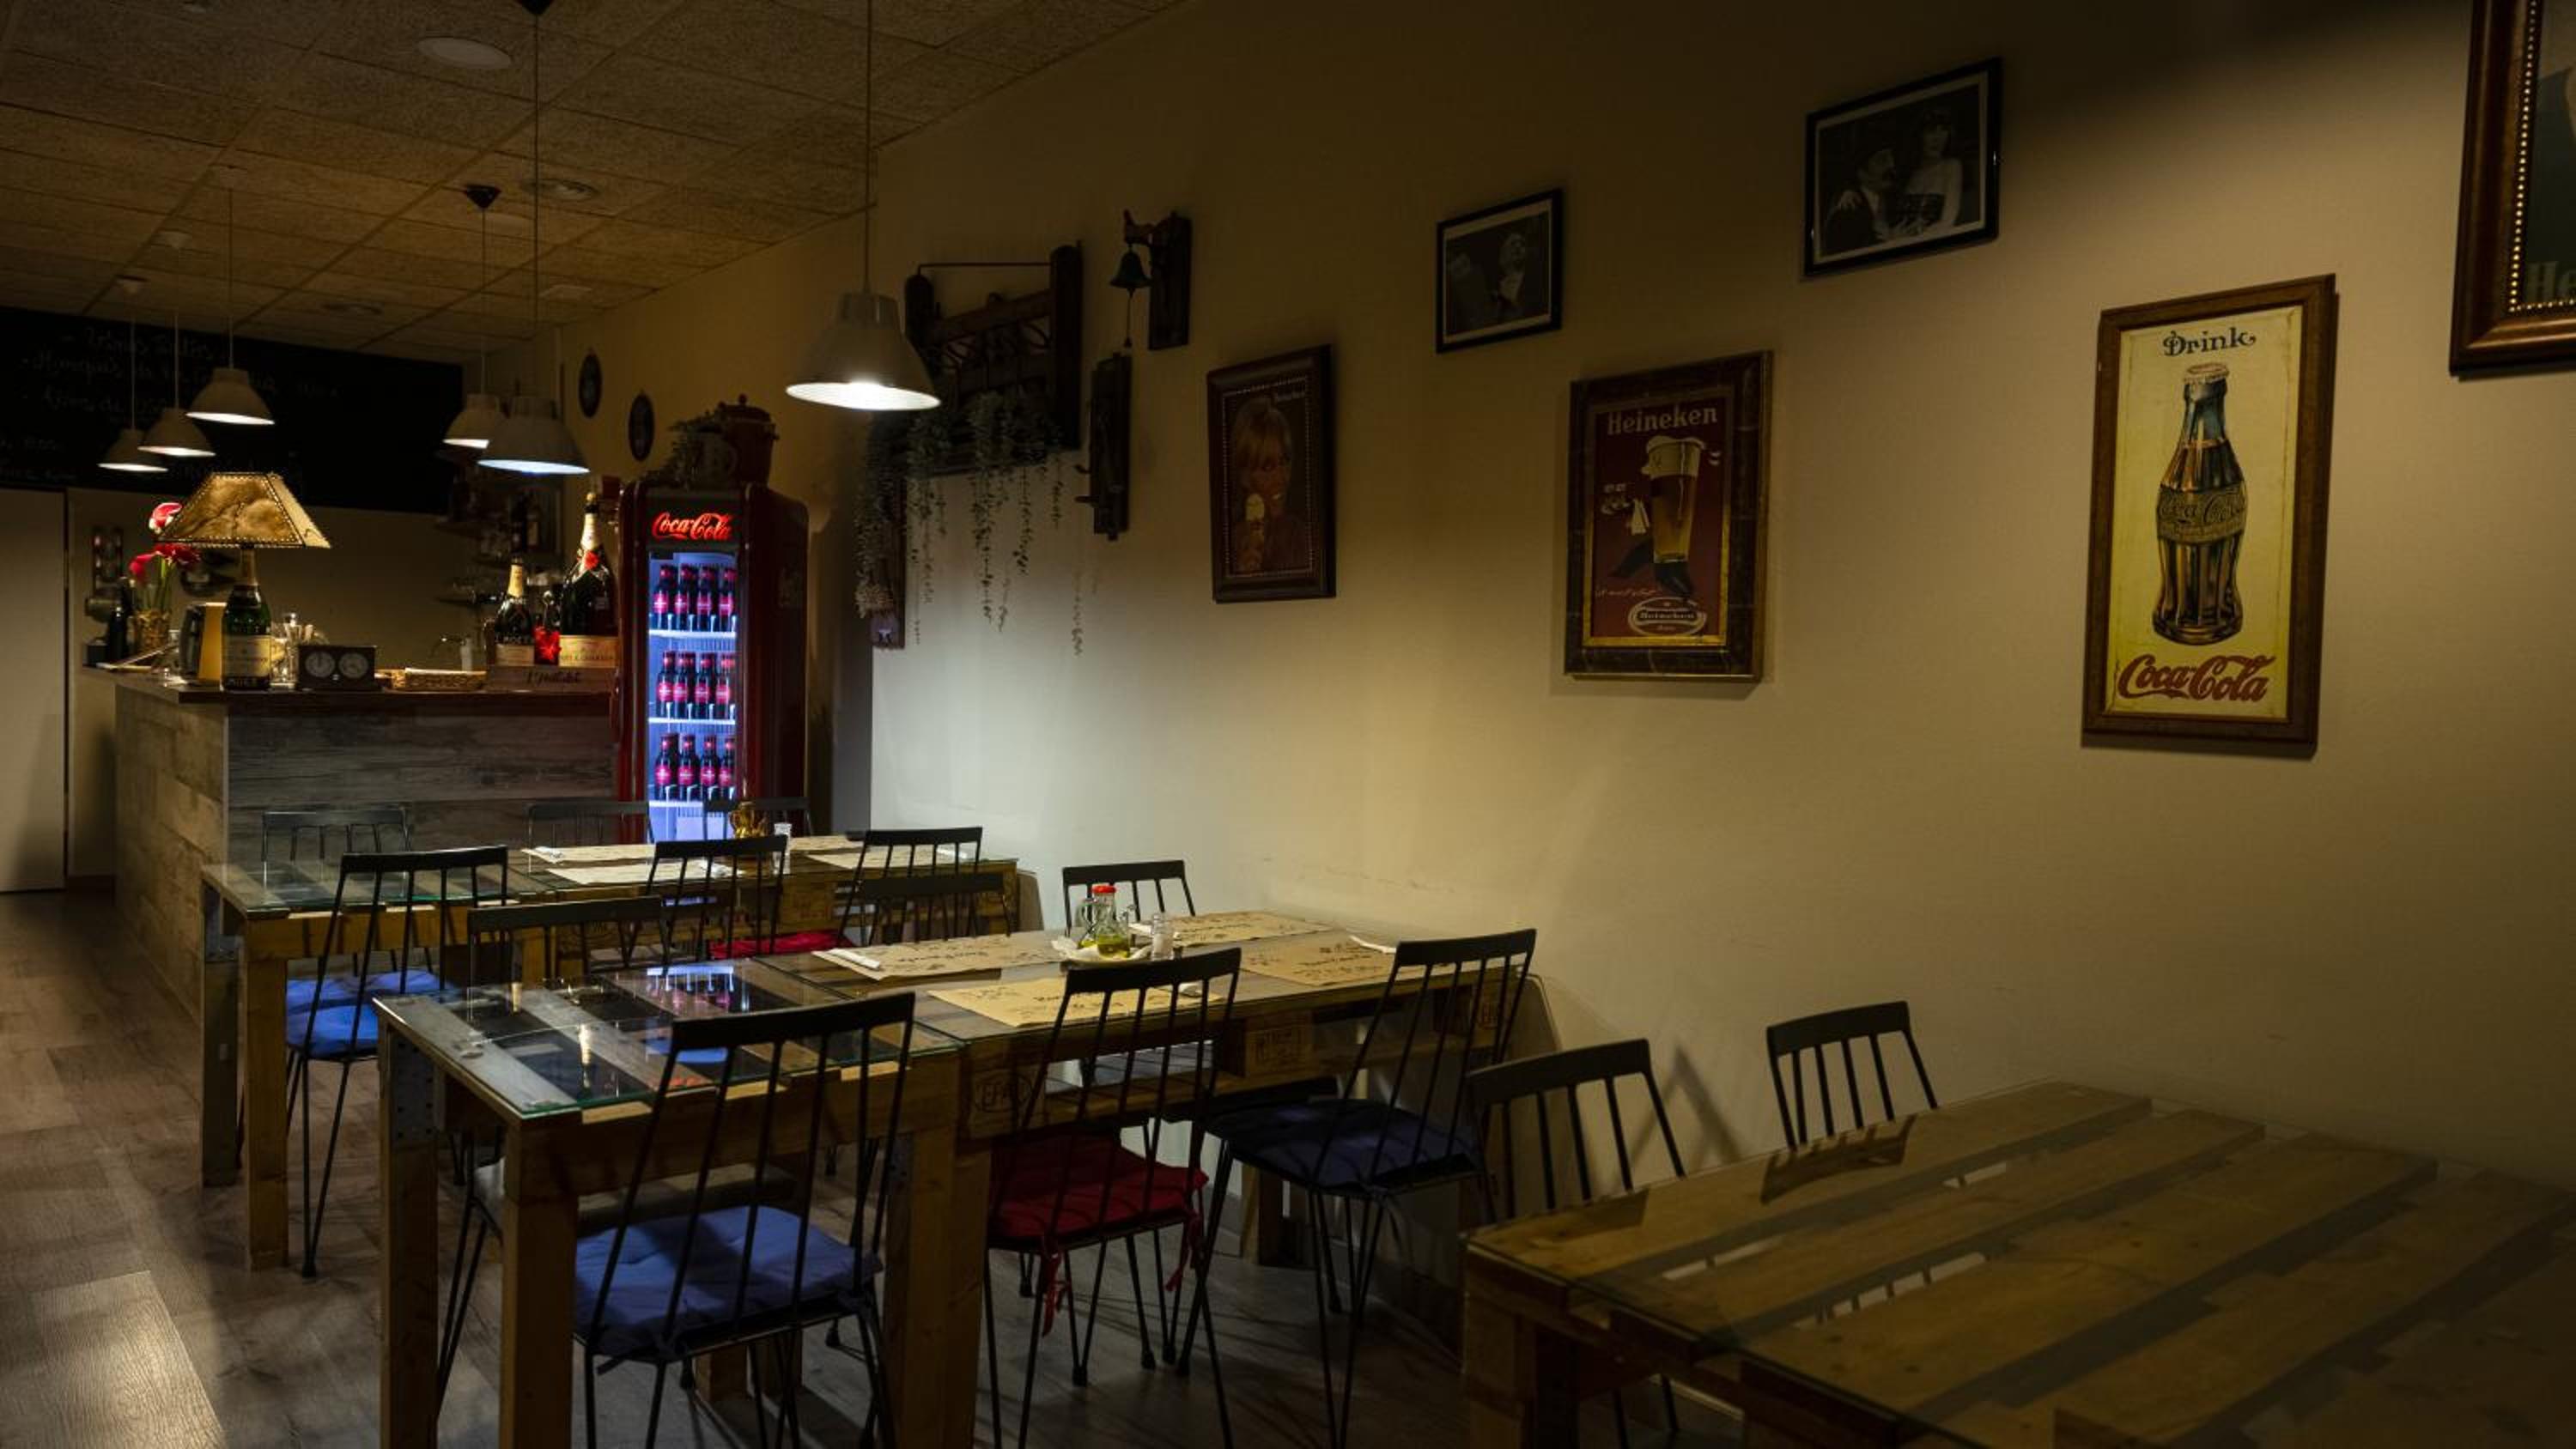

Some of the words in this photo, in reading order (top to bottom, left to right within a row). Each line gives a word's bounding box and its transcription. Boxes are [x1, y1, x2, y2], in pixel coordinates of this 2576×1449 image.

[2163, 327, 2256, 356] Drink
[1607, 403, 1718, 436] Heineken
[652, 511, 733, 541] Coca-Cola
[2117, 653, 2276, 702] Coca-Cola
